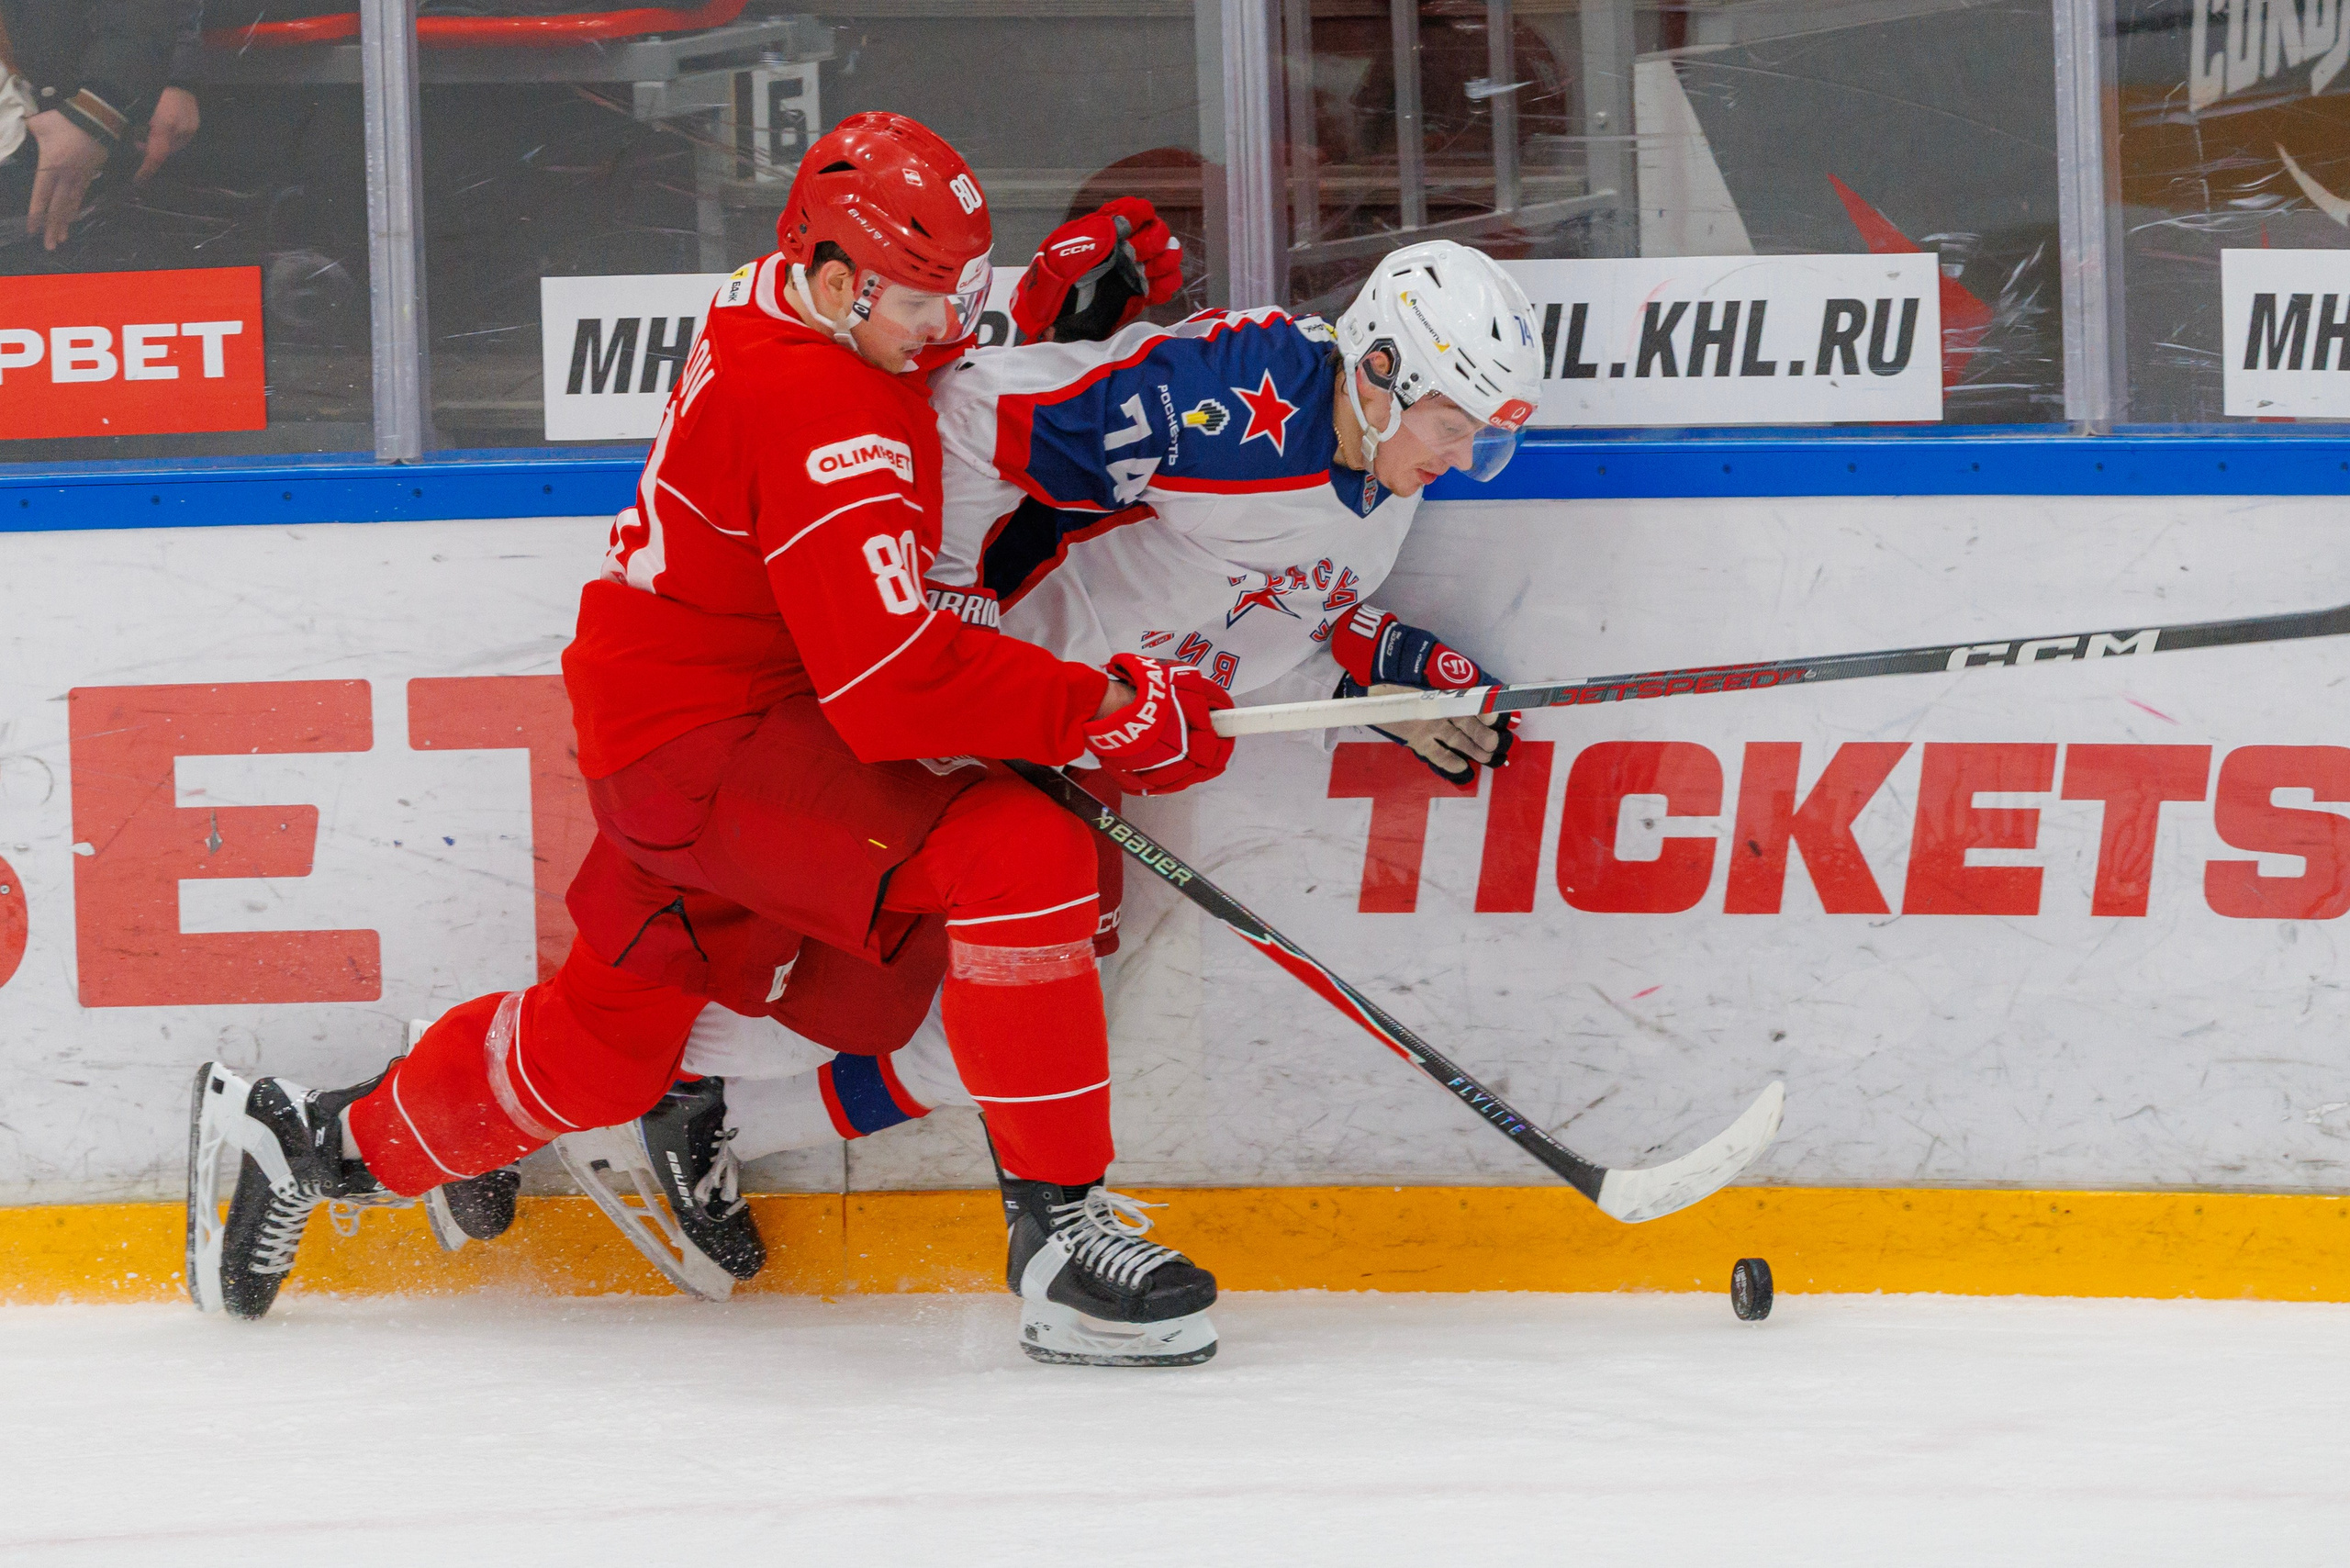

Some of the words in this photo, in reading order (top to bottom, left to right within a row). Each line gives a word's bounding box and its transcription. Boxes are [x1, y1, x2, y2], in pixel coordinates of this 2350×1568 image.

[949, 173, 983, 215] 80
[1058, 242, 1096, 257] CCM
[1513, 315, 1535, 348] 74
[1103, 393, 1163, 505] 74
[862, 530, 930, 616] 80
[1945, 628, 2161, 671] CCM
[1088, 655, 1167, 750] СПАРТАК
[1550, 670, 1780, 707] JETSPEED
[1327, 740, 2350, 920] TICKETS
[1447, 1076, 1527, 1136] FLYLITE
